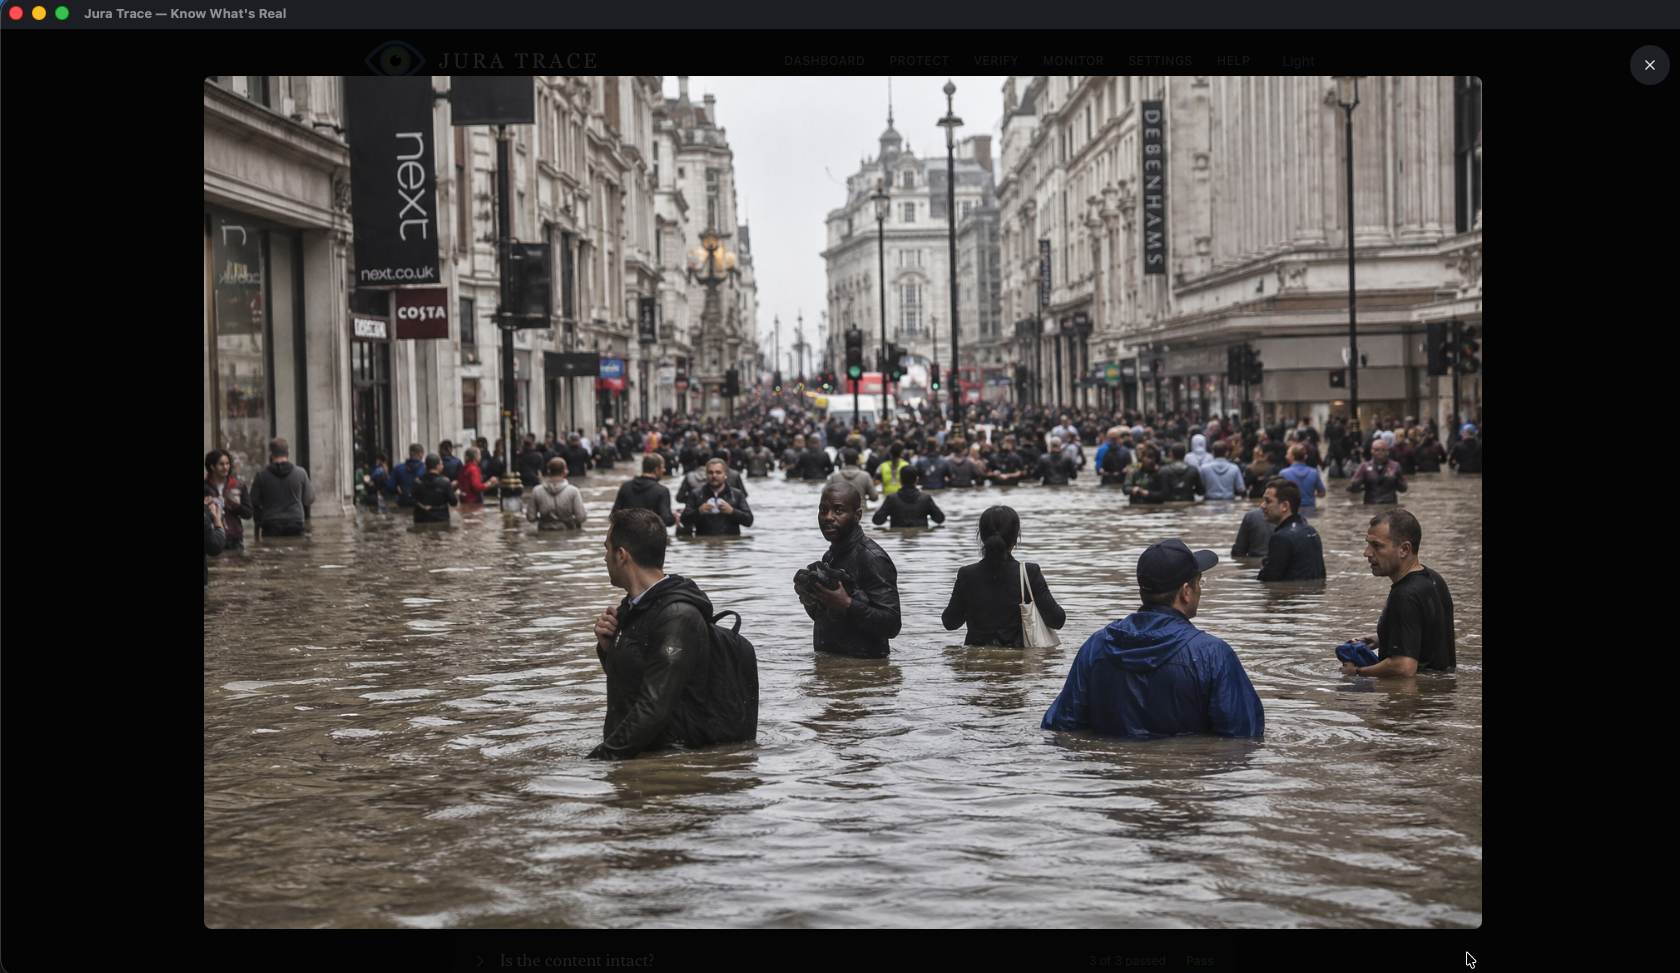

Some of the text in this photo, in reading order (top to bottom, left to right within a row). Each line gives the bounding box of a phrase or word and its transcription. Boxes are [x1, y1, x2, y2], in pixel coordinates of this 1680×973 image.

[84, 8, 113, 19] Jura
[116, 8, 153, 19] Trace
[170, 8, 207, 19] Know
[209, 8, 256, 19] What's
[259, 8, 287, 19] Real
[438, 52, 598, 70] JURA TRACE
[784, 55, 865, 66] DASHBOARD
[889, 55, 950, 66] PROTECT
[973, 55, 1019, 66] VERIFY
[1043, 55, 1104, 66] MONITOR
[1128, 55, 1193, 66] SETTINGS
[1217, 55, 1250, 66] HELP
[1282, 54, 1316, 70] Light
[395, 131, 429, 241] next
[1144, 109, 1164, 266] DEBENHAMS
[361, 265, 434, 281] next.co.uk
[397, 306, 446, 322] COSTA
[500, 953, 655, 967] Is the content intact?
[1089, 955, 1166, 968] 3 of 3 passed
[1186, 955, 1215, 966] Pass
